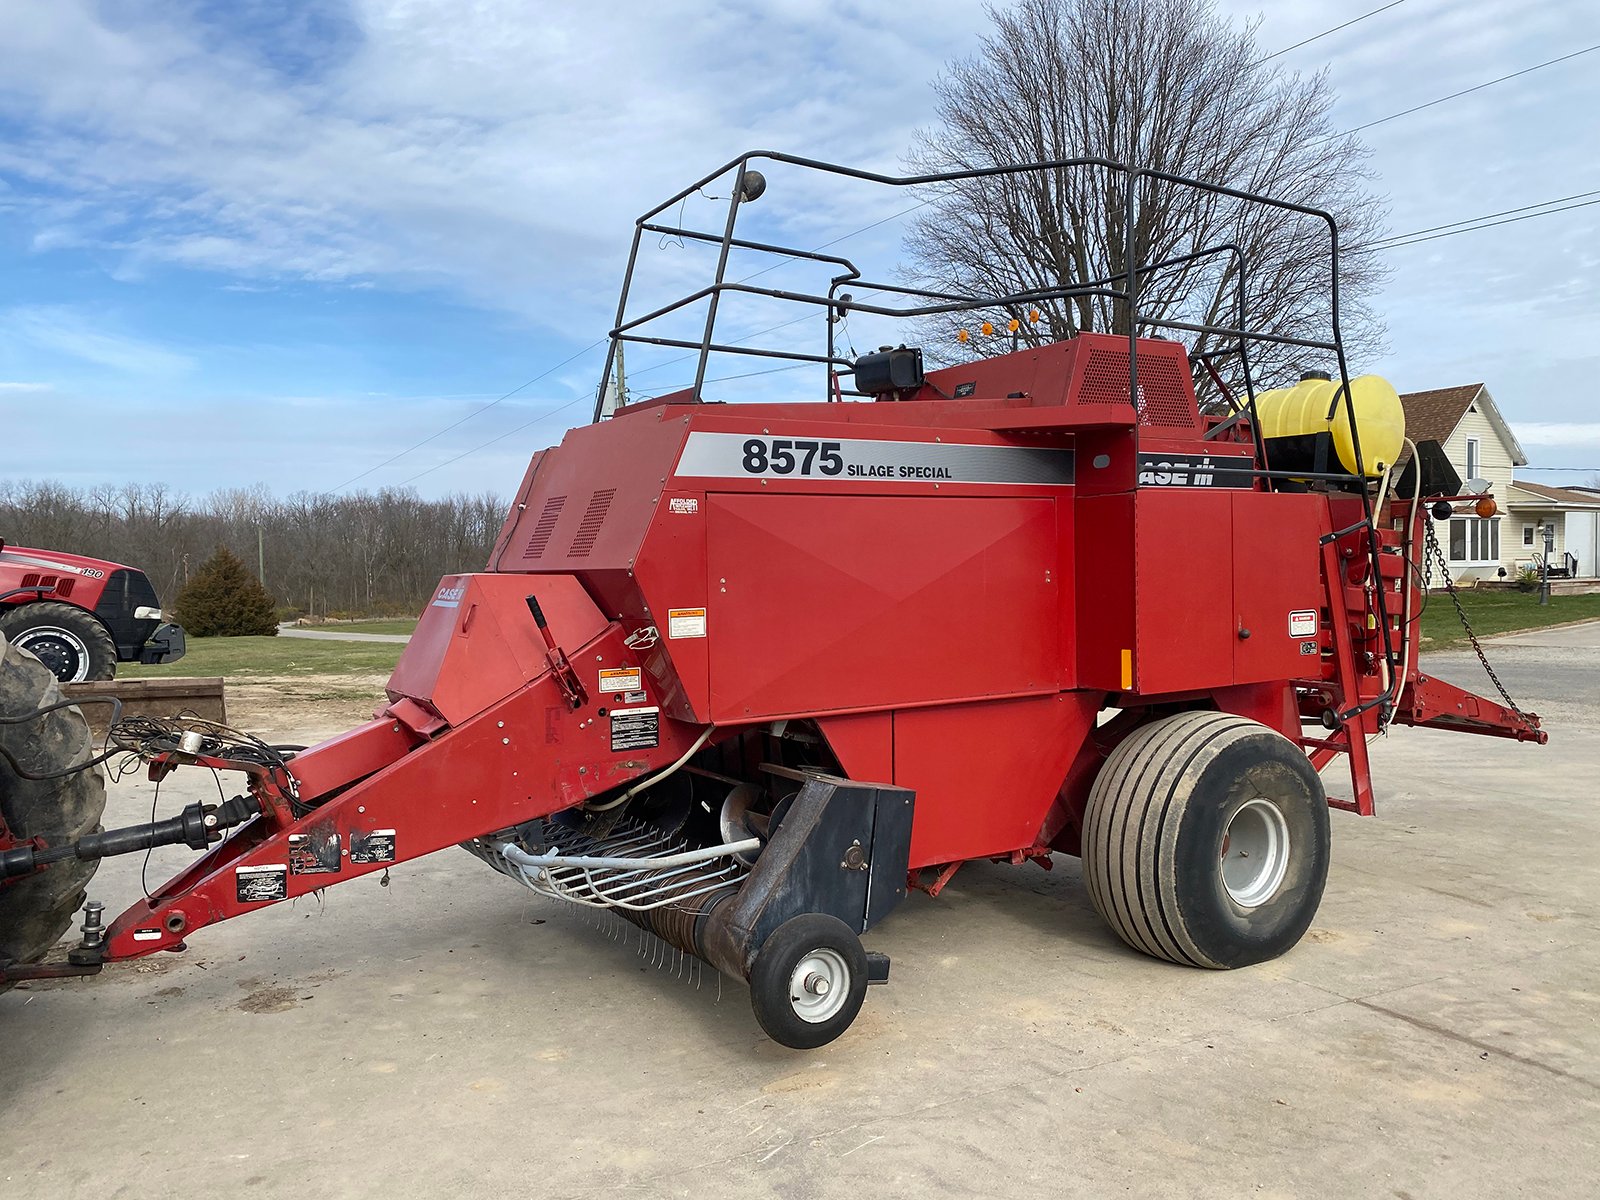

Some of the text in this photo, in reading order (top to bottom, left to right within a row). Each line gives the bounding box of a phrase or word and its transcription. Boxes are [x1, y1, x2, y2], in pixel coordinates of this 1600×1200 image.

[742, 439, 952, 479] 8575 SILAGE SPECIAL
[1138, 462, 1190, 485] ASE
[83, 568, 104, 579] 190
[437, 588, 458, 600] CASE
